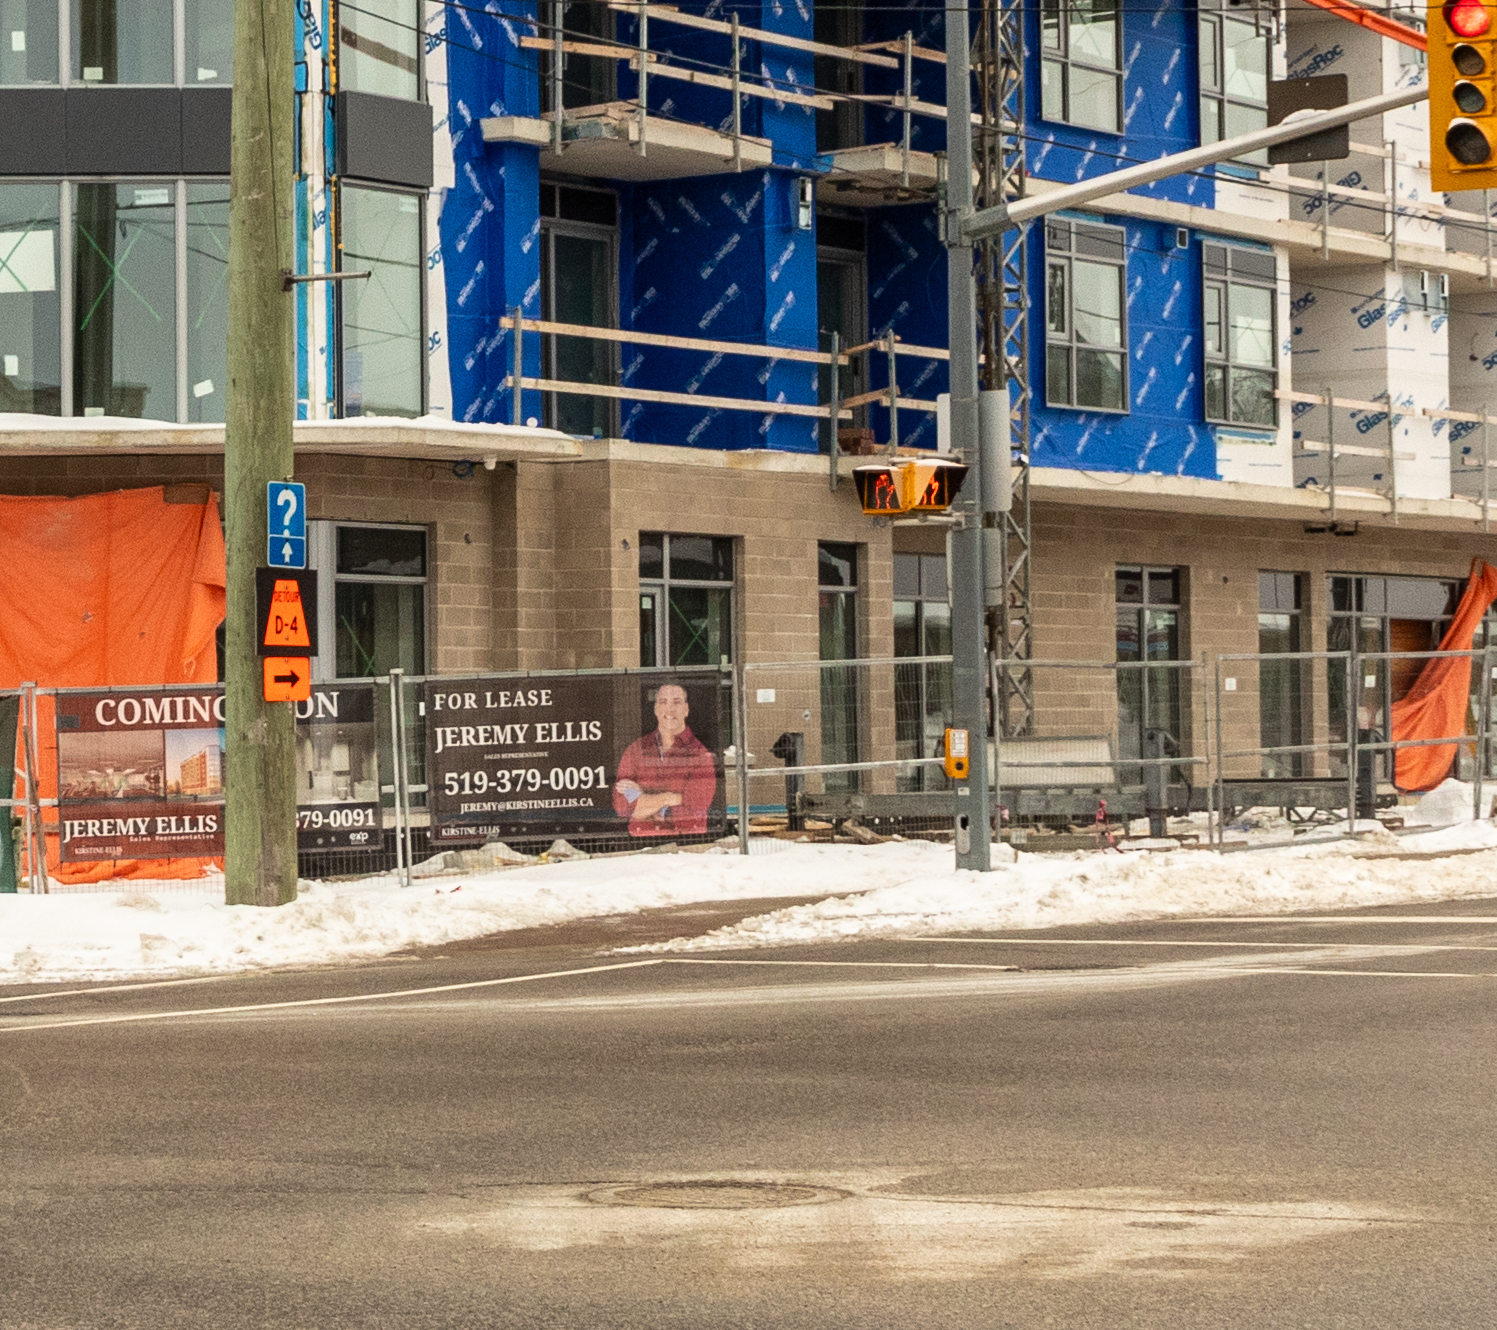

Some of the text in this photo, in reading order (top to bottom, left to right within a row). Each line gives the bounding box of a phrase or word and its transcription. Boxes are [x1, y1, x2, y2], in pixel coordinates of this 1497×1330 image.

[273, 591, 301, 603] DETOUR
[275, 615, 299, 634] D-4
[434, 689, 553, 710] FOR LEASE
[434, 720, 603, 753] JEREMY ELLIS
[444, 765, 609, 796] 519-379-0091
[460, 797, 594, 814] JEREMY@KIRSTINEELLIS.CA
[63, 814, 219, 844] JEREMY ELLIS
[441, 825, 501, 837] KIRSTINE-ELLIS
